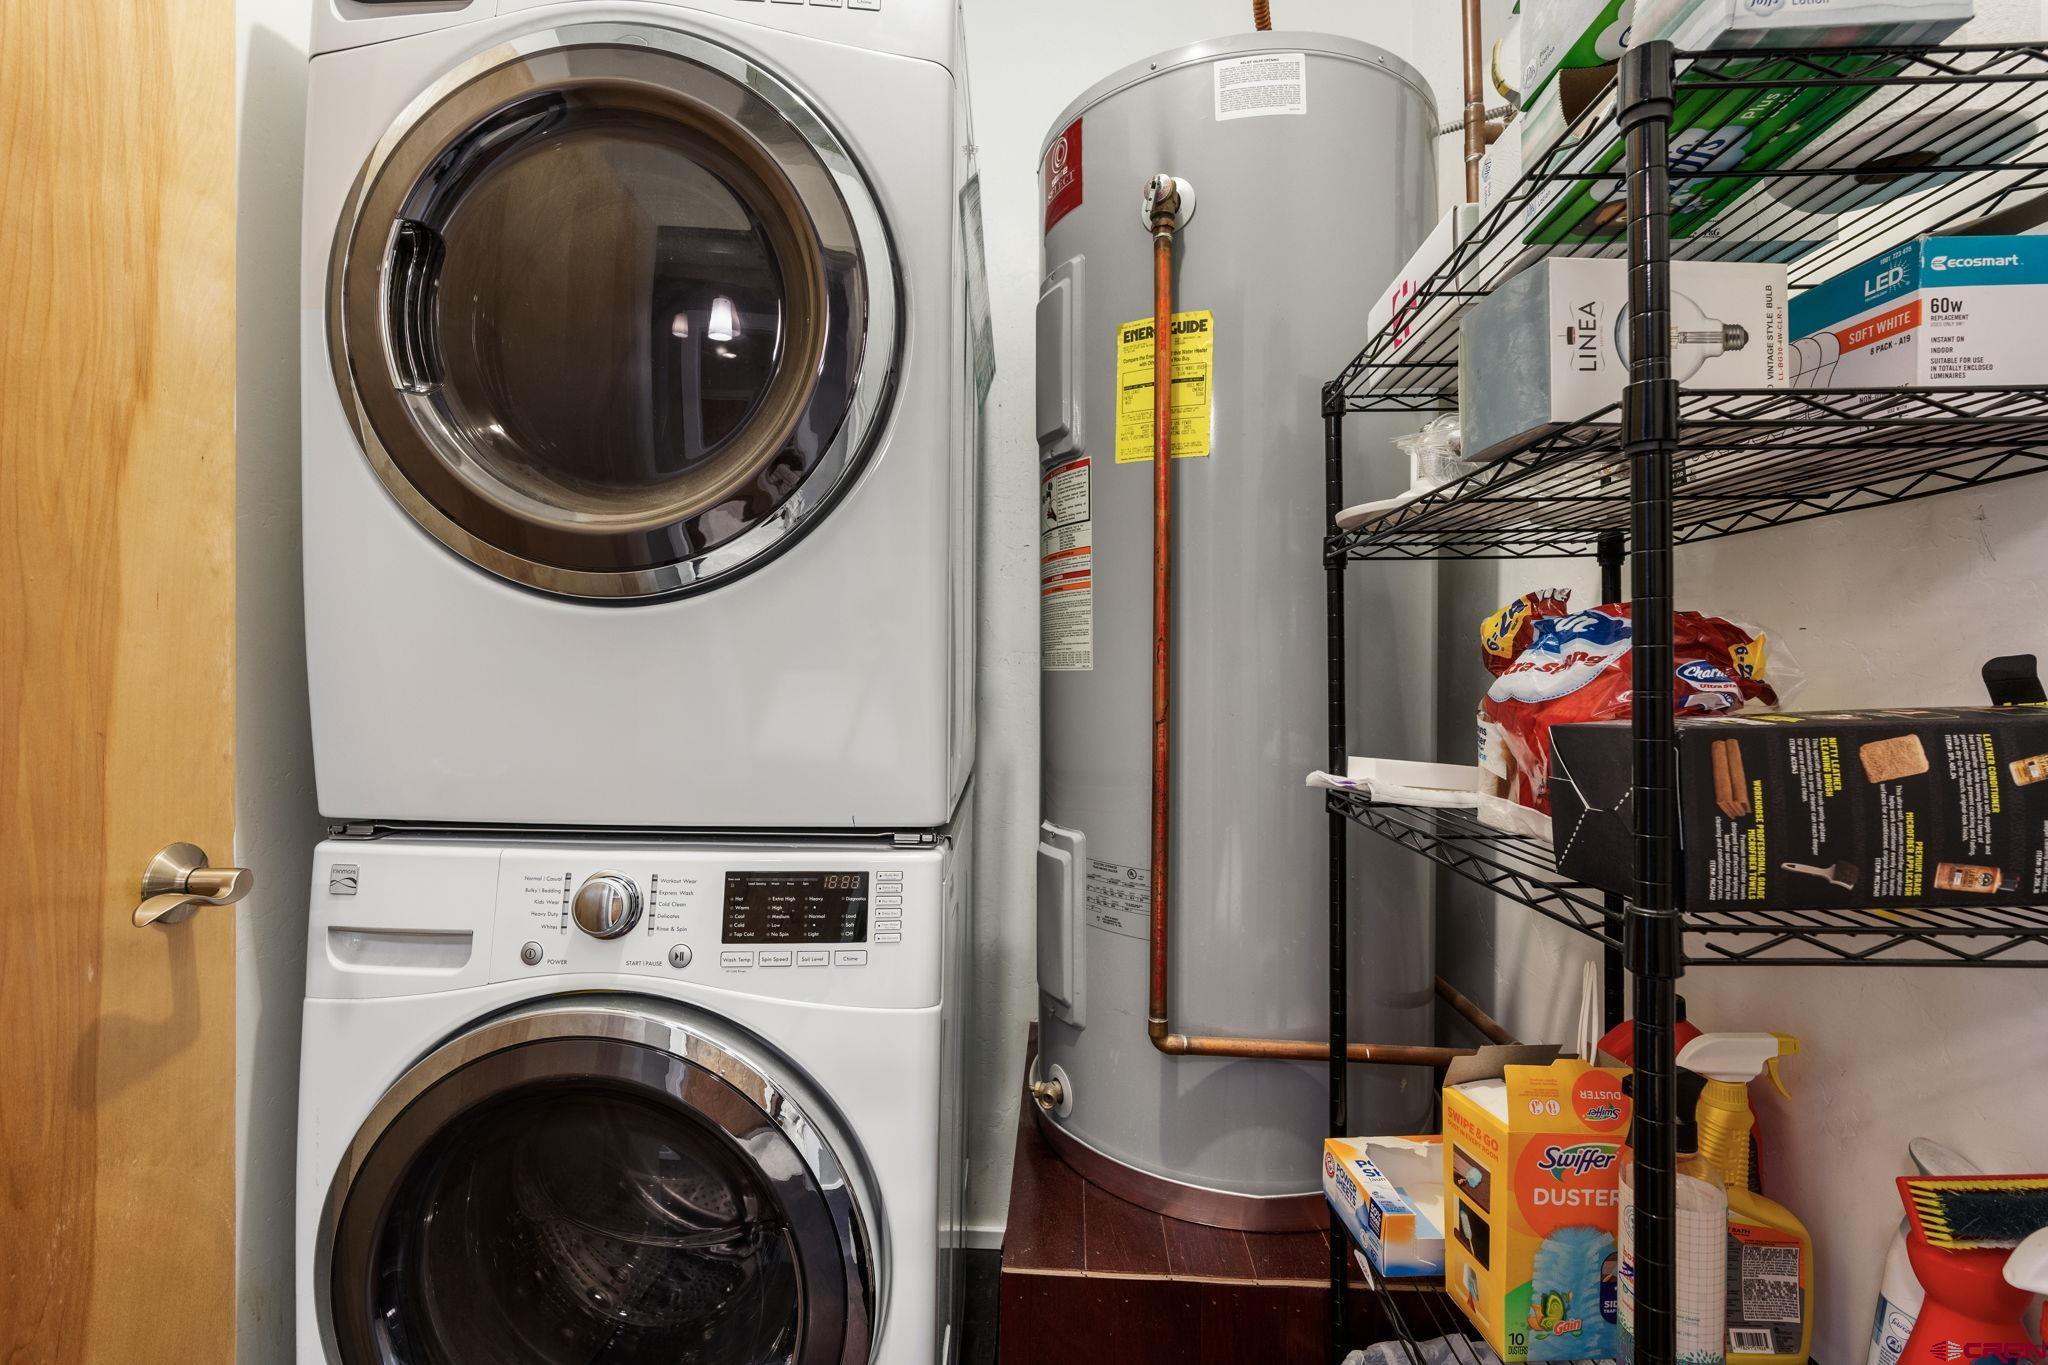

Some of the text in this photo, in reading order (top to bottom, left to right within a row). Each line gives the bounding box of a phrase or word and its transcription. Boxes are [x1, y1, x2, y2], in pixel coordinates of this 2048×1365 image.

[1948, 254, 2018, 267] ecosmart
[1765, 284, 1773, 308] BULB
[1865, 267, 1903, 297] LED
[1578, 301, 1596, 372] LINEA
[1766, 313, 1774, 340] STYLE
[1849, 311, 1911, 345] SOFT WHITE
[1123, 355, 1139, 364] Compare
[1870, 347, 1874, 355] 8
[1876, 342, 1893, 354] PACK
[1899, 335, 1911, 346] A19
[1820, 738, 1834, 797] CLEANING BRUSH
[1829, 738, 1841, 790] NIFTY LEATHER
[1983, 734, 2000, 813] LEATHER CONDITIONER
[1968, 806, 1976, 828] cracking
[1748, 829, 1756, 870] MICROFIBER
[1753, 780, 1766, 900] WORKHORSE PROFESSIONAL GRADE
[1905, 812, 1915, 896] MICROFIBER APPLICATOR
[1913, 842, 1923, 896] PREMIUM GRADE
[1580, 1090, 1621, 1100] DUSTER
[1586, 1105, 1621, 1120] Swiffer
[1448, 1106, 1499, 1152] SWIPE & GO
[1538, 1147, 1616, 1174] Swiffer
[1336, 1163, 1357, 1193] POWER
[1336, 1175, 1356, 1207] SHEETS
[1508, 1333, 1525, 1345] 10
[1553, 1319, 1582, 1336] Gain
[1508, 1346, 1528, 1355] DUSTERS
